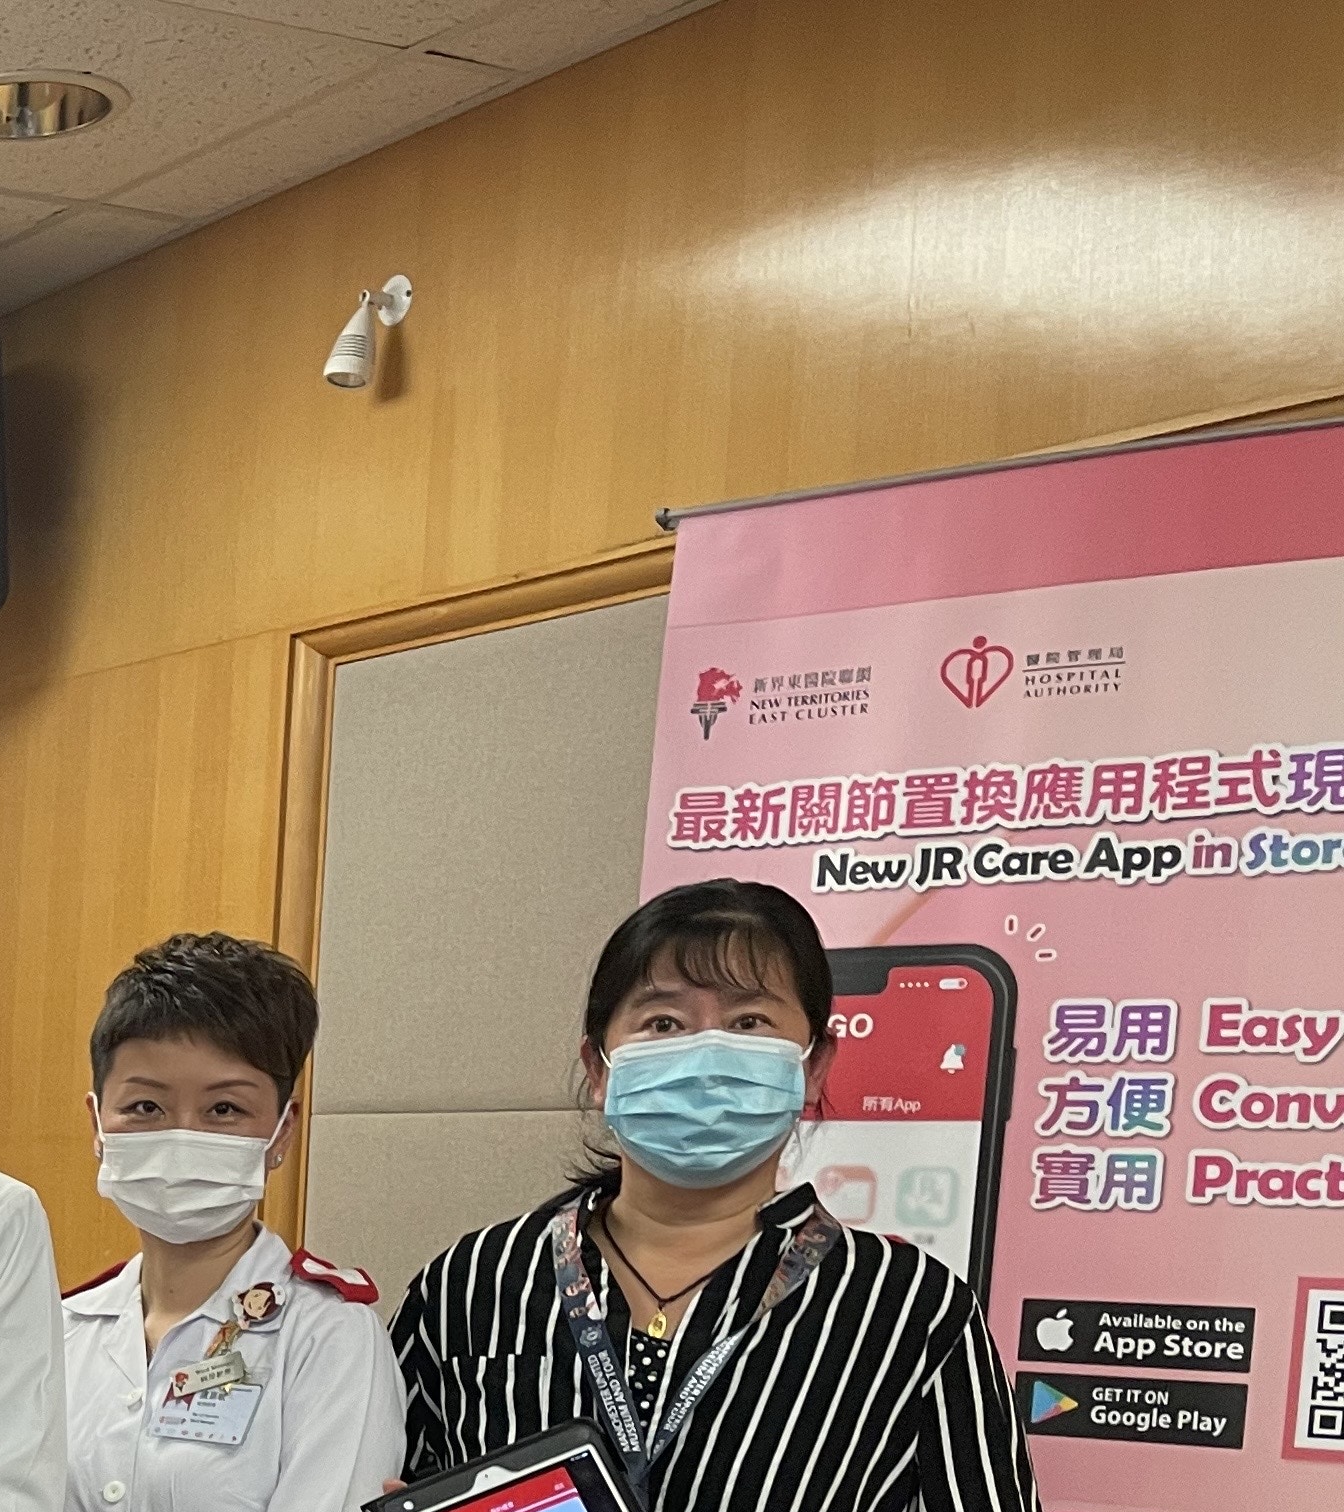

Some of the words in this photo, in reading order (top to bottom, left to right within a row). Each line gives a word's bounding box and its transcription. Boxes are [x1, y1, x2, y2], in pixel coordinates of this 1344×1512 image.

[1023, 682, 1122, 699] AUTHORITY
[1024, 668, 1122, 686] HOSPITAL
[750, 697, 783, 711] NEW
[787, 688, 870, 708] TERRITORIES
[749, 710, 788, 725] EAST
[795, 703, 869, 721] CLUSTER
[672, 748, 1344, 843] 最新關節置換應用程式現
[817, 852, 907, 890] New
[914, 846, 963, 884] JR
[973, 844, 1074, 876] Care
[1089, 838, 1181, 877] App
[1193, 834, 1232, 868] in
[1246, 833, 1344, 869] Stor
[828, 1013, 874, 1039] GO
[1048, 1003, 1170, 1057] 易用
[1207, 1004, 1340, 1056] Easy
[1041, 1076, 1168, 1132] 方便
[1035, 1150, 1157, 1205] 實用
[1099, 1312, 1181, 1333] Available
[1187, 1318, 1209, 1332] on
[1213, 1315, 1246, 1333] the
[1094, 1333, 1157, 1360] App
[1163, 1334, 1244, 1360] Store
[609, 1379, 627, 1403] AND
[1092, 1387, 1119, 1403] GET
[1123, 1388, 1140, 1403] IT
[1145, 1390, 1169, 1405] ON
[618, 1404, 642, 1452] MUSEUM
[1090, 1406, 1172, 1431] Google
[1177, 1411, 1227, 1437] Play
